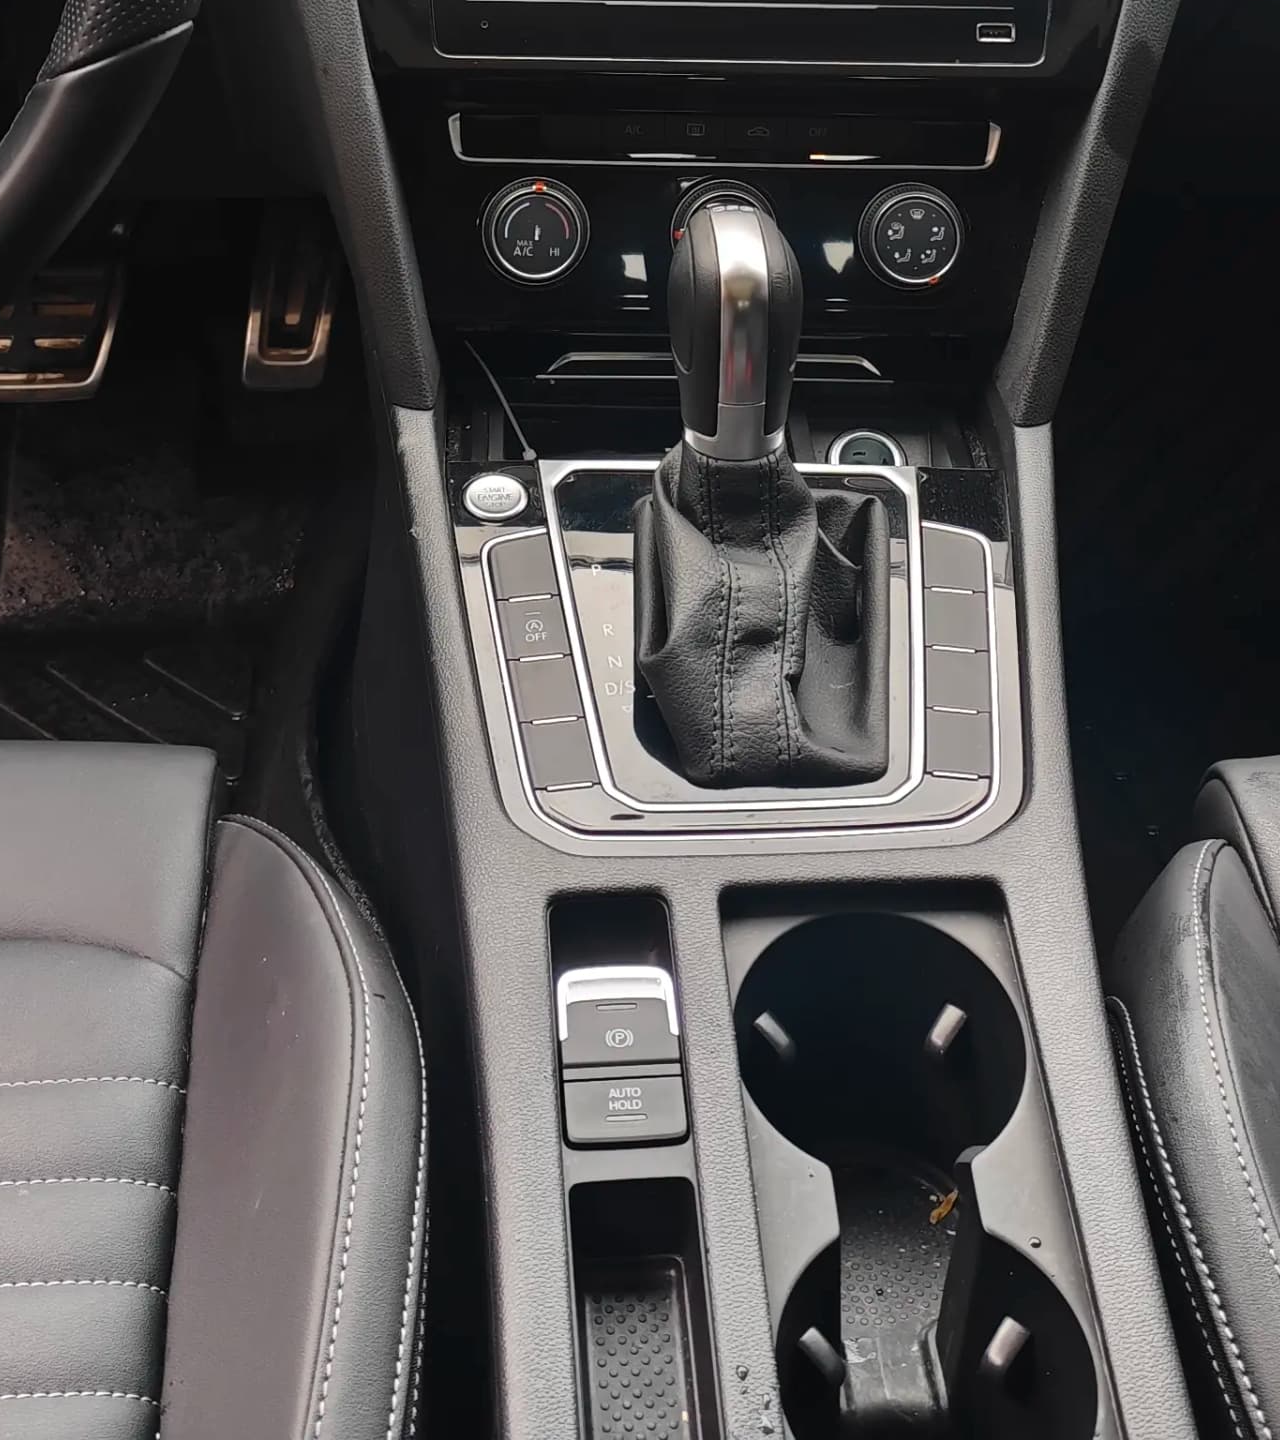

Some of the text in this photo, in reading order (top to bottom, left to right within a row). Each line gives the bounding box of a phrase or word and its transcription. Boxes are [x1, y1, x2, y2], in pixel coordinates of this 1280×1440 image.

[516, 239, 534, 247] MAX
[513, 246, 535, 257] A/C
[549, 247, 560, 257] HI
[477, 493, 513, 501] ENGINE
[591, 564, 602, 577] P
[602, 624, 615, 637] R
[525, 632, 548, 643] OFF
[607, 655, 623, 669] N
[605, 681, 636, 696] D/S
[608, 1086, 642, 1098] AUTO
[608, 1099, 642, 1111] HOLD
